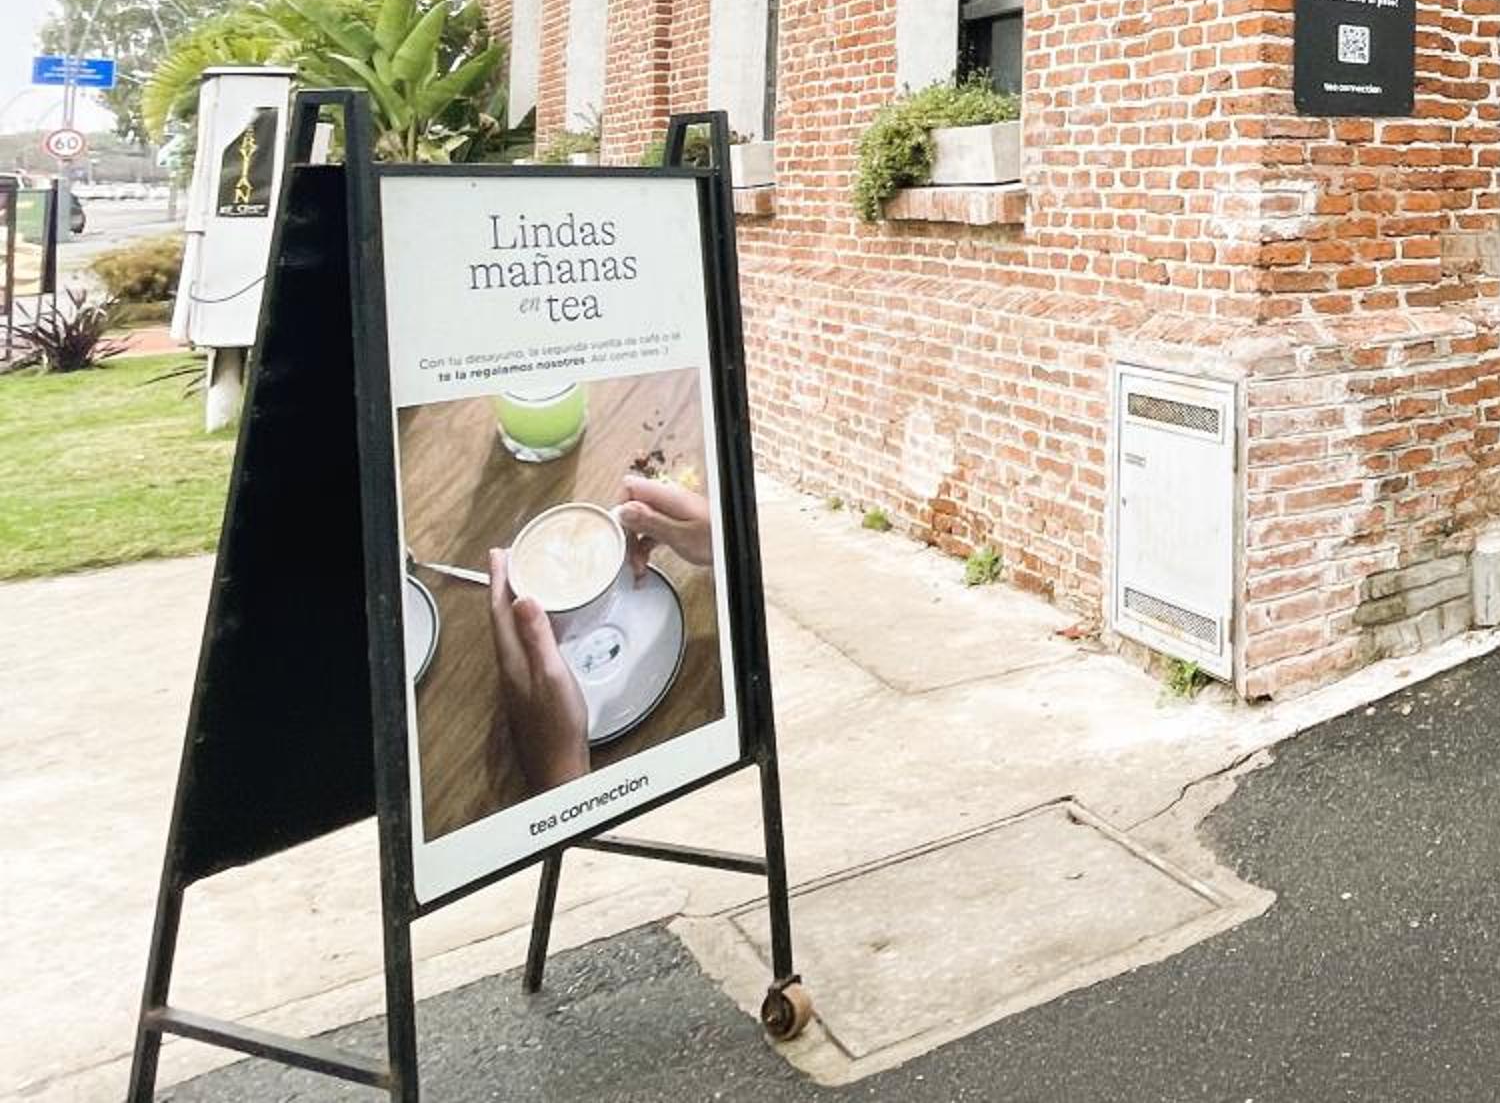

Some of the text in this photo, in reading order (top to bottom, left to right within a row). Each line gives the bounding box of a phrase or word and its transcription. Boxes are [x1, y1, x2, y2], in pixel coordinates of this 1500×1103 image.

[55, 137, 79, 150] 60
[489, 212, 617, 250] Lindas
[469, 252, 638, 290] mañanas
[519, 294, 602, 322] en tea
[419, 358, 445, 370] Con
[455, 370, 466, 380] la
[470, 364, 533, 379] regalamos
[529, 776, 649, 836] tea connection
